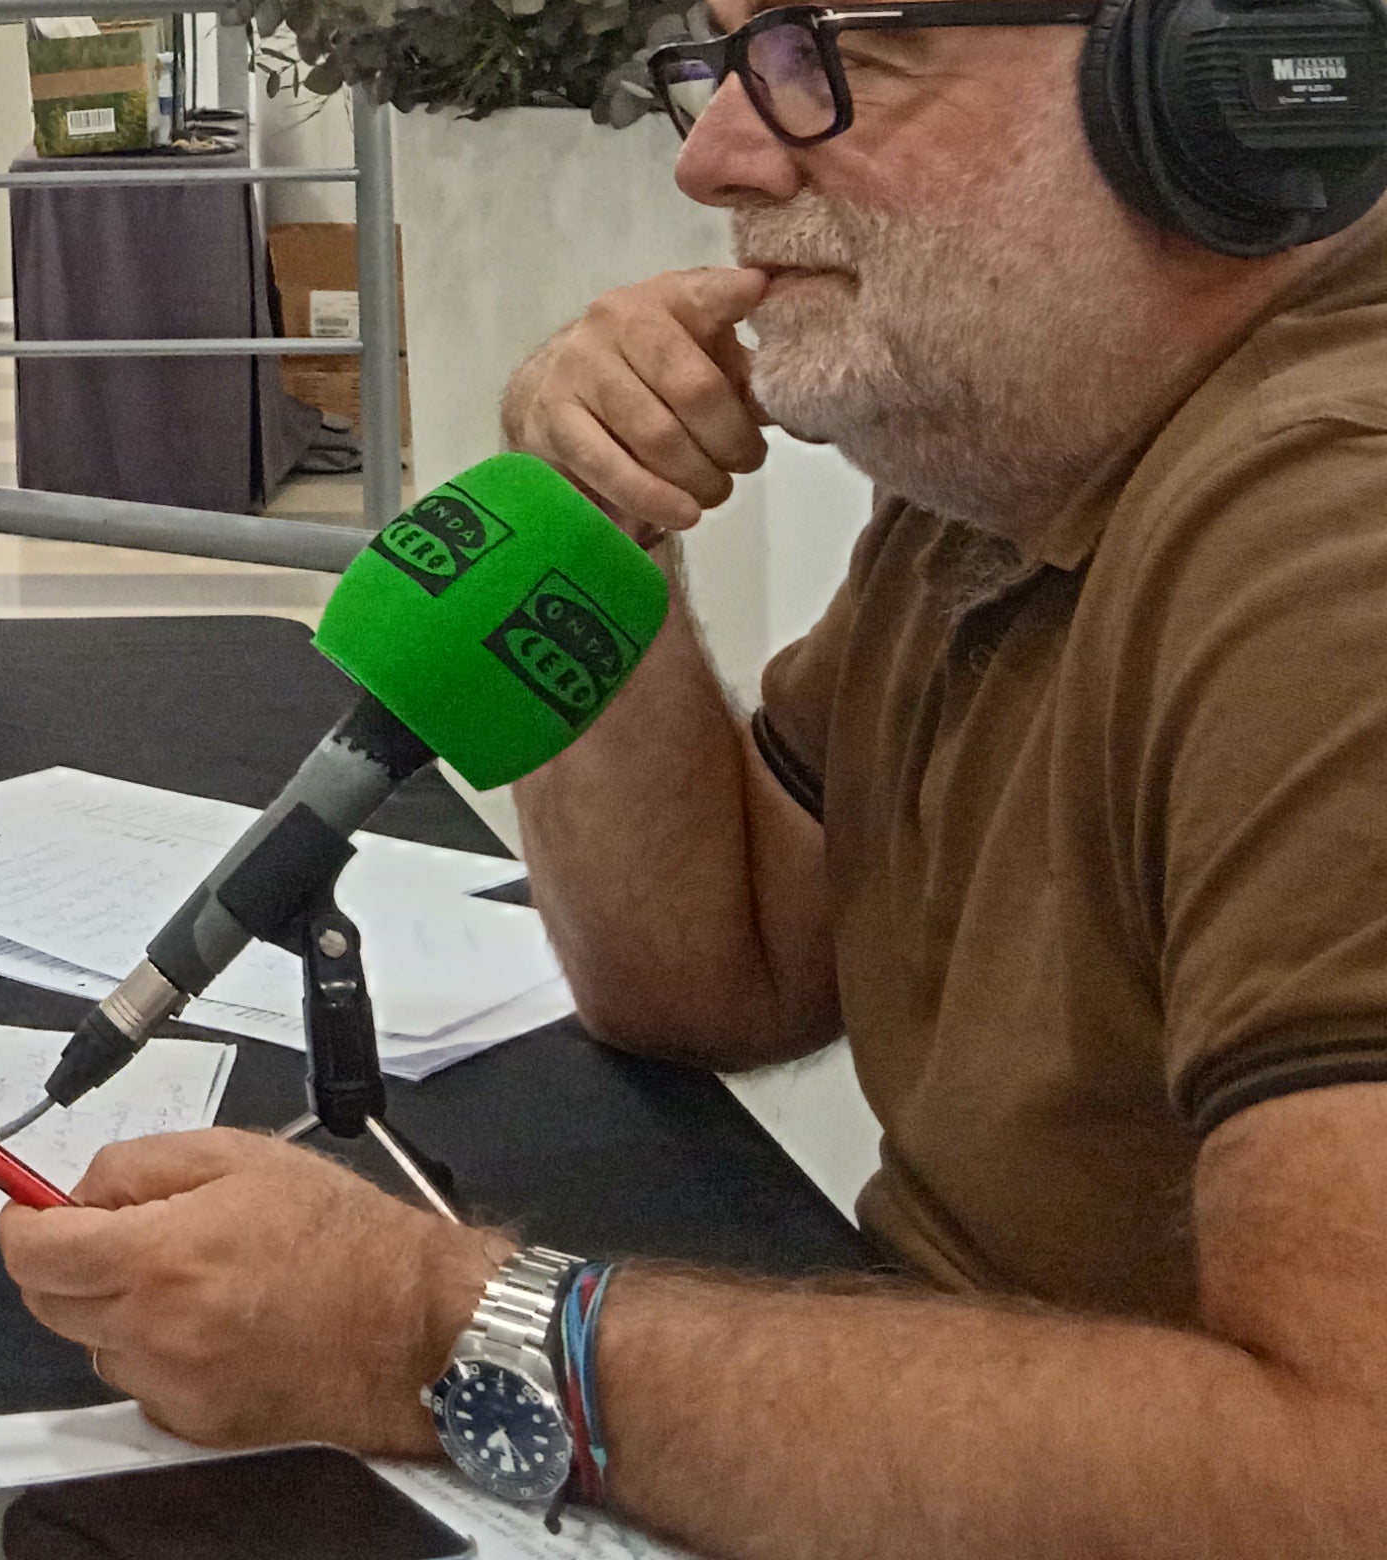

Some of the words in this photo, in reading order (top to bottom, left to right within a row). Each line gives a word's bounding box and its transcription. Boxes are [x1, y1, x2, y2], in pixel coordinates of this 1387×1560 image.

[1272, 57, 1347, 80] MAESTRO
[423, 498, 476, 544] ONDA
[389, 524, 448, 571] CERO
[521, 636, 591, 703] CERO
